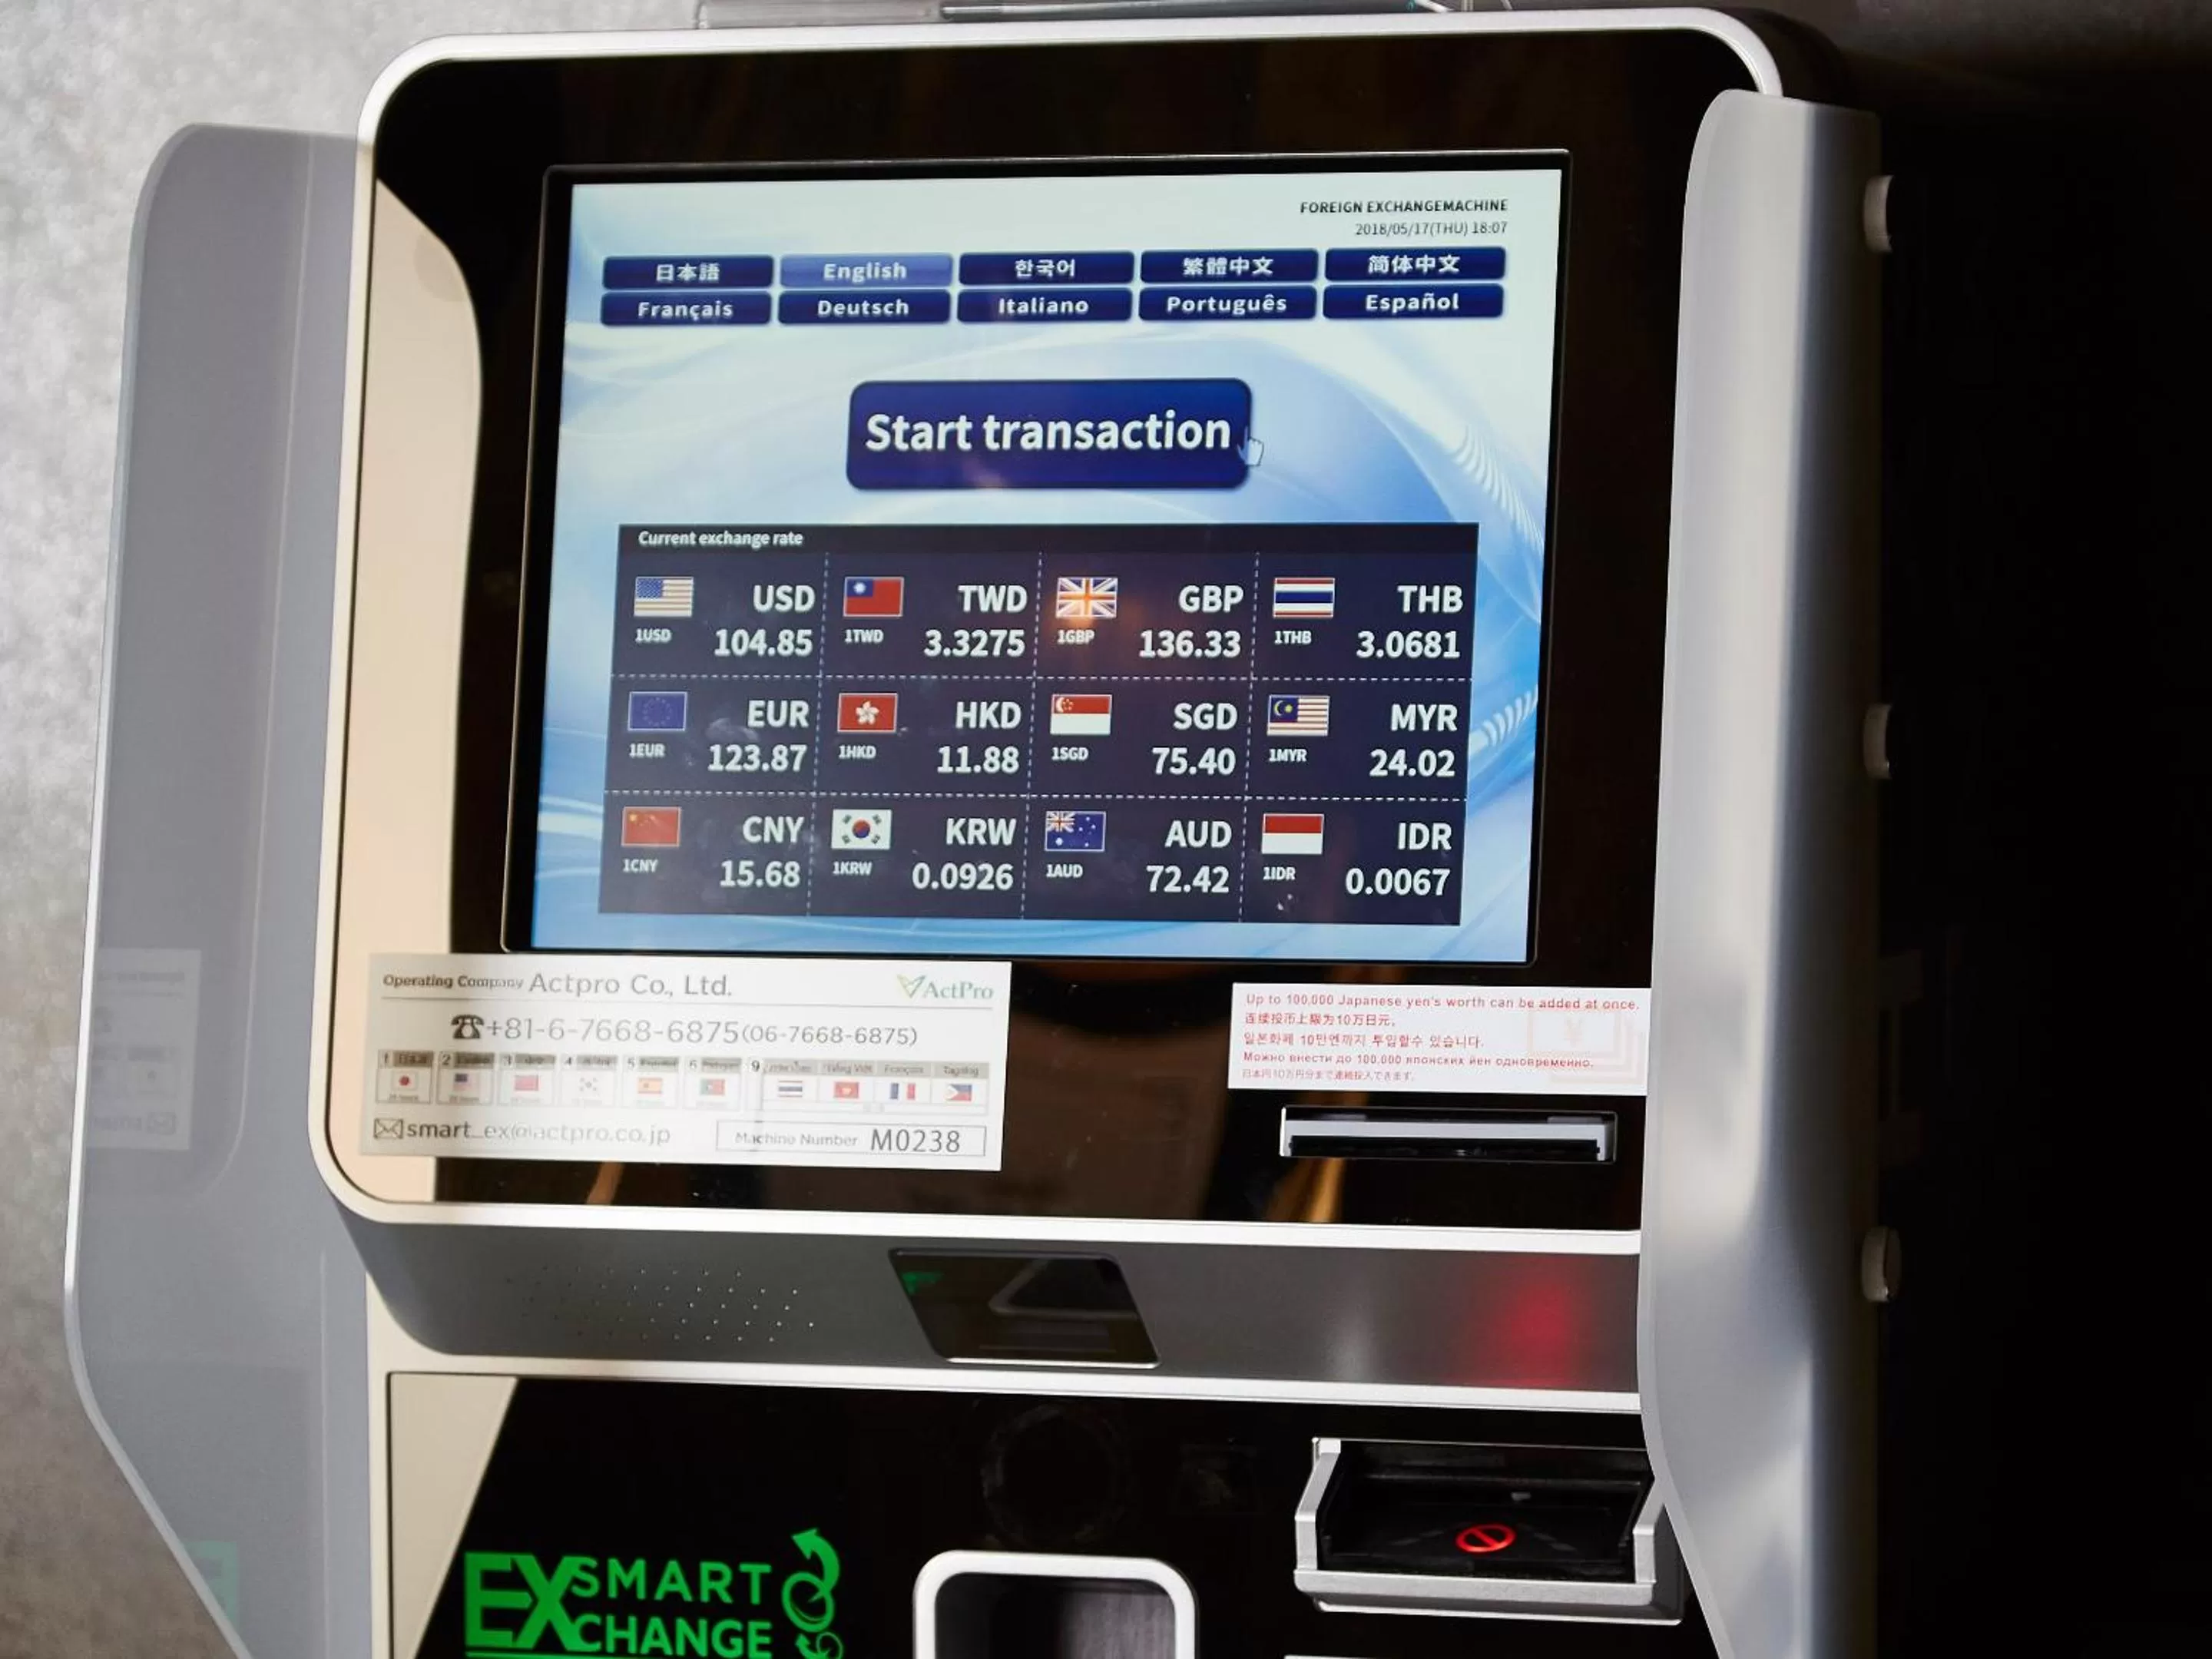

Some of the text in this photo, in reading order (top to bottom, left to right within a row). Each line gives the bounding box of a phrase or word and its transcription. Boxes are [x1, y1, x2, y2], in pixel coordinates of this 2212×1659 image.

[1300, 199, 1508, 214] FOREIGN EXCHANGEMACHINE
[1356, 220, 1508, 237] 2018/05/17(THU) 18:07
[656, 263, 720, 282] 日本語
[824, 261, 907, 283] English
[1015, 259, 1076, 278] 한국어
[1182, 256, 1274, 276] 繁體中文
[1368, 253, 1461, 275] 简体中文
[637, 300, 733, 322] Français
[817, 299, 909, 316] Deutsch
[998, 296, 1089, 316] Italiano
[1166, 295, 1287, 316] Português
[1365, 293, 1460, 313] Español
[865, 409, 1231, 451] Start transaction
[637, 530, 803, 549] Current exchange rate
[753, 584, 816, 613] USD
[957, 584, 1028, 613] TWD
[1177, 584, 1244, 614] GBP
[1396, 584, 1464, 614] THB
[634, 628, 672, 644] 1USD
[714, 629, 813, 657] 104.85
[844, 628, 884, 644] 1TWD
[923, 629, 1025, 658] 3.3275
[1057, 629, 1095, 644] 1GBP
[1138, 630, 1242, 659] 136.33
[1274, 630, 1313, 645] 1THB
[1356, 630, 1461, 659] 3.0681
[747, 699, 810, 728] EUR
[955, 700, 1022, 729] HKD
[1173, 701, 1238, 731] SGD
[1389, 703, 1459, 732] MYR
[628, 743, 665, 758] 1EUR
[707, 744, 808, 772] 123.87
[838, 744, 877, 760] 1HKD
[937, 745, 1020, 773] 11.88
[1051, 747, 1088, 761] 1SGD
[1151, 747, 1237, 776] 75.40
[1269, 747, 1307, 763] 1MYR
[1369, 749, 1455, 777] 24.02
[742, 816, 805, 843] CNY
[945, 817, 1017, 846] KRW
[1164, 820, 1233, 849] AUD
[1397, 822, 1453, 851] IDR
[622, 858, 658, 873] 1CNY
[720, 859, 802, 888] 15.68
[832, 861, 873, 876] 1KRW
[912, 862, 1014, 891] 0.0926
[1045, 863, 1084, 879] 1AUD
[1263, 866, 1296, 881] 1IDR
[1146, 865, 1230, 893] 72.42
[1345, 866, 1451, 896] 0.0067
[382, 972, 733, 998] Operating Company Actpro Co., Ltd.
[923, 980, 994, 1000] ActPro
[1246, 994, 1264, 1006] Up
[1268, 994, 1281, 1005] to
[1338, 995, 1402, 1008] Japanese
[1406, 996, 1442, 1009] yen's
[1446, 997, 1485, 1008] worth
[1490, 999, 1515, 1008] can
[1518, 998, 1535, 1009] be
[1538, 998, 1582, 1010] added
[1584, 999, 1598, 1010] at
[1602, 1000, 1640, 1010] once.
[1429, 1035, 1484, 1049] 있습니다.
[1243, 1052, 1285, 1062] Можно
[1290, 1054, 1333, 1063] внести
[1336, 1055, 1352, 1064] до
[1406, 1057, 1464, 1066] японских
[1495, 1058, 1594, 1068] одновременно.
[734, 1128, 961, 1153] Machine Number M0238
[570, 1557, 773, 1605] SMART
[465, 1551, 581, 1651] EX
